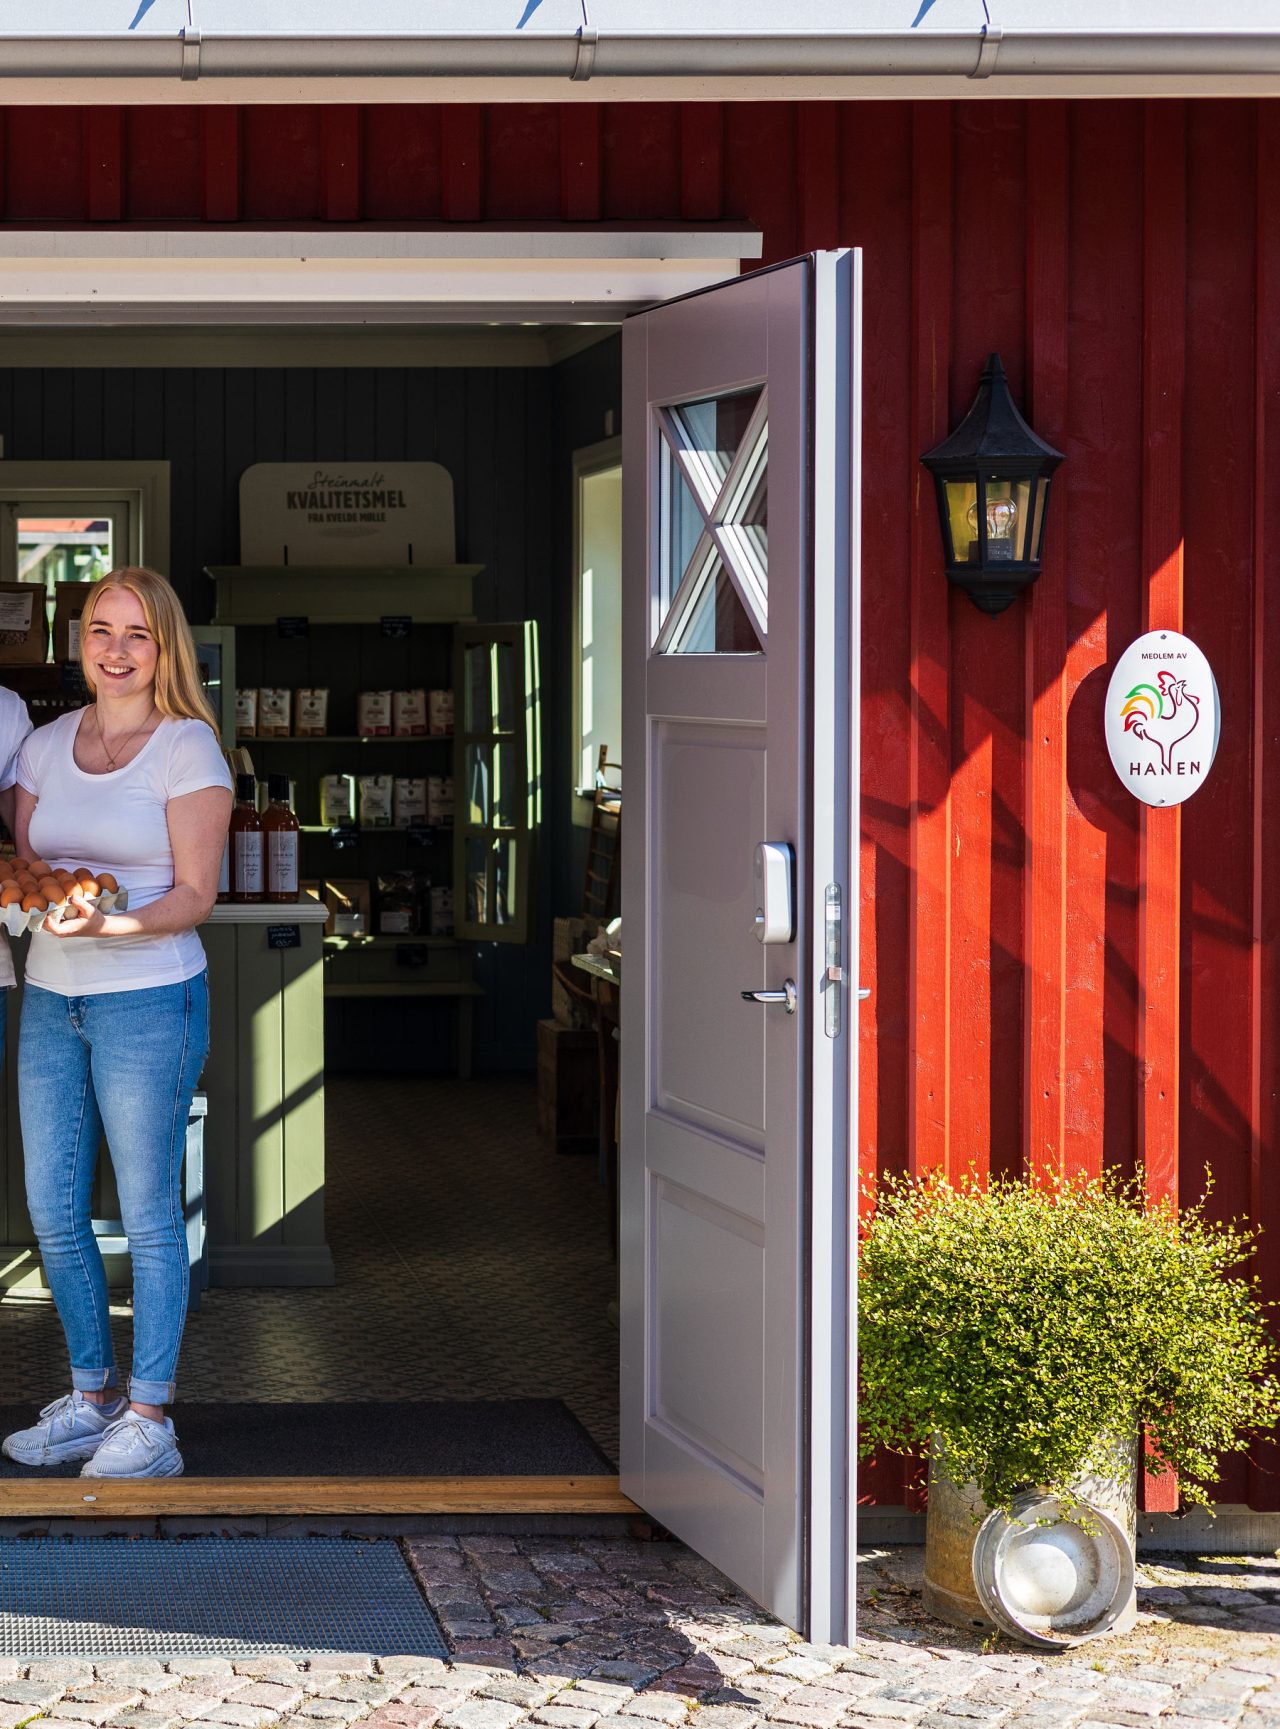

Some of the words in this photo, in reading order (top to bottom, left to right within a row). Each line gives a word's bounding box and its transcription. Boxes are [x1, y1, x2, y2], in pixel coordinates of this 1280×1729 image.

[307, 470, 385, 490] Steinmalt
[286, 490, 407, 509] KVALITETSMEL
[307, 513, 324, 523] FRA
[326, 512, 357, 523] KVELDE
[1176, 652, 1188, 660] AV
[1129, 761, 1201, 776] HANEN
